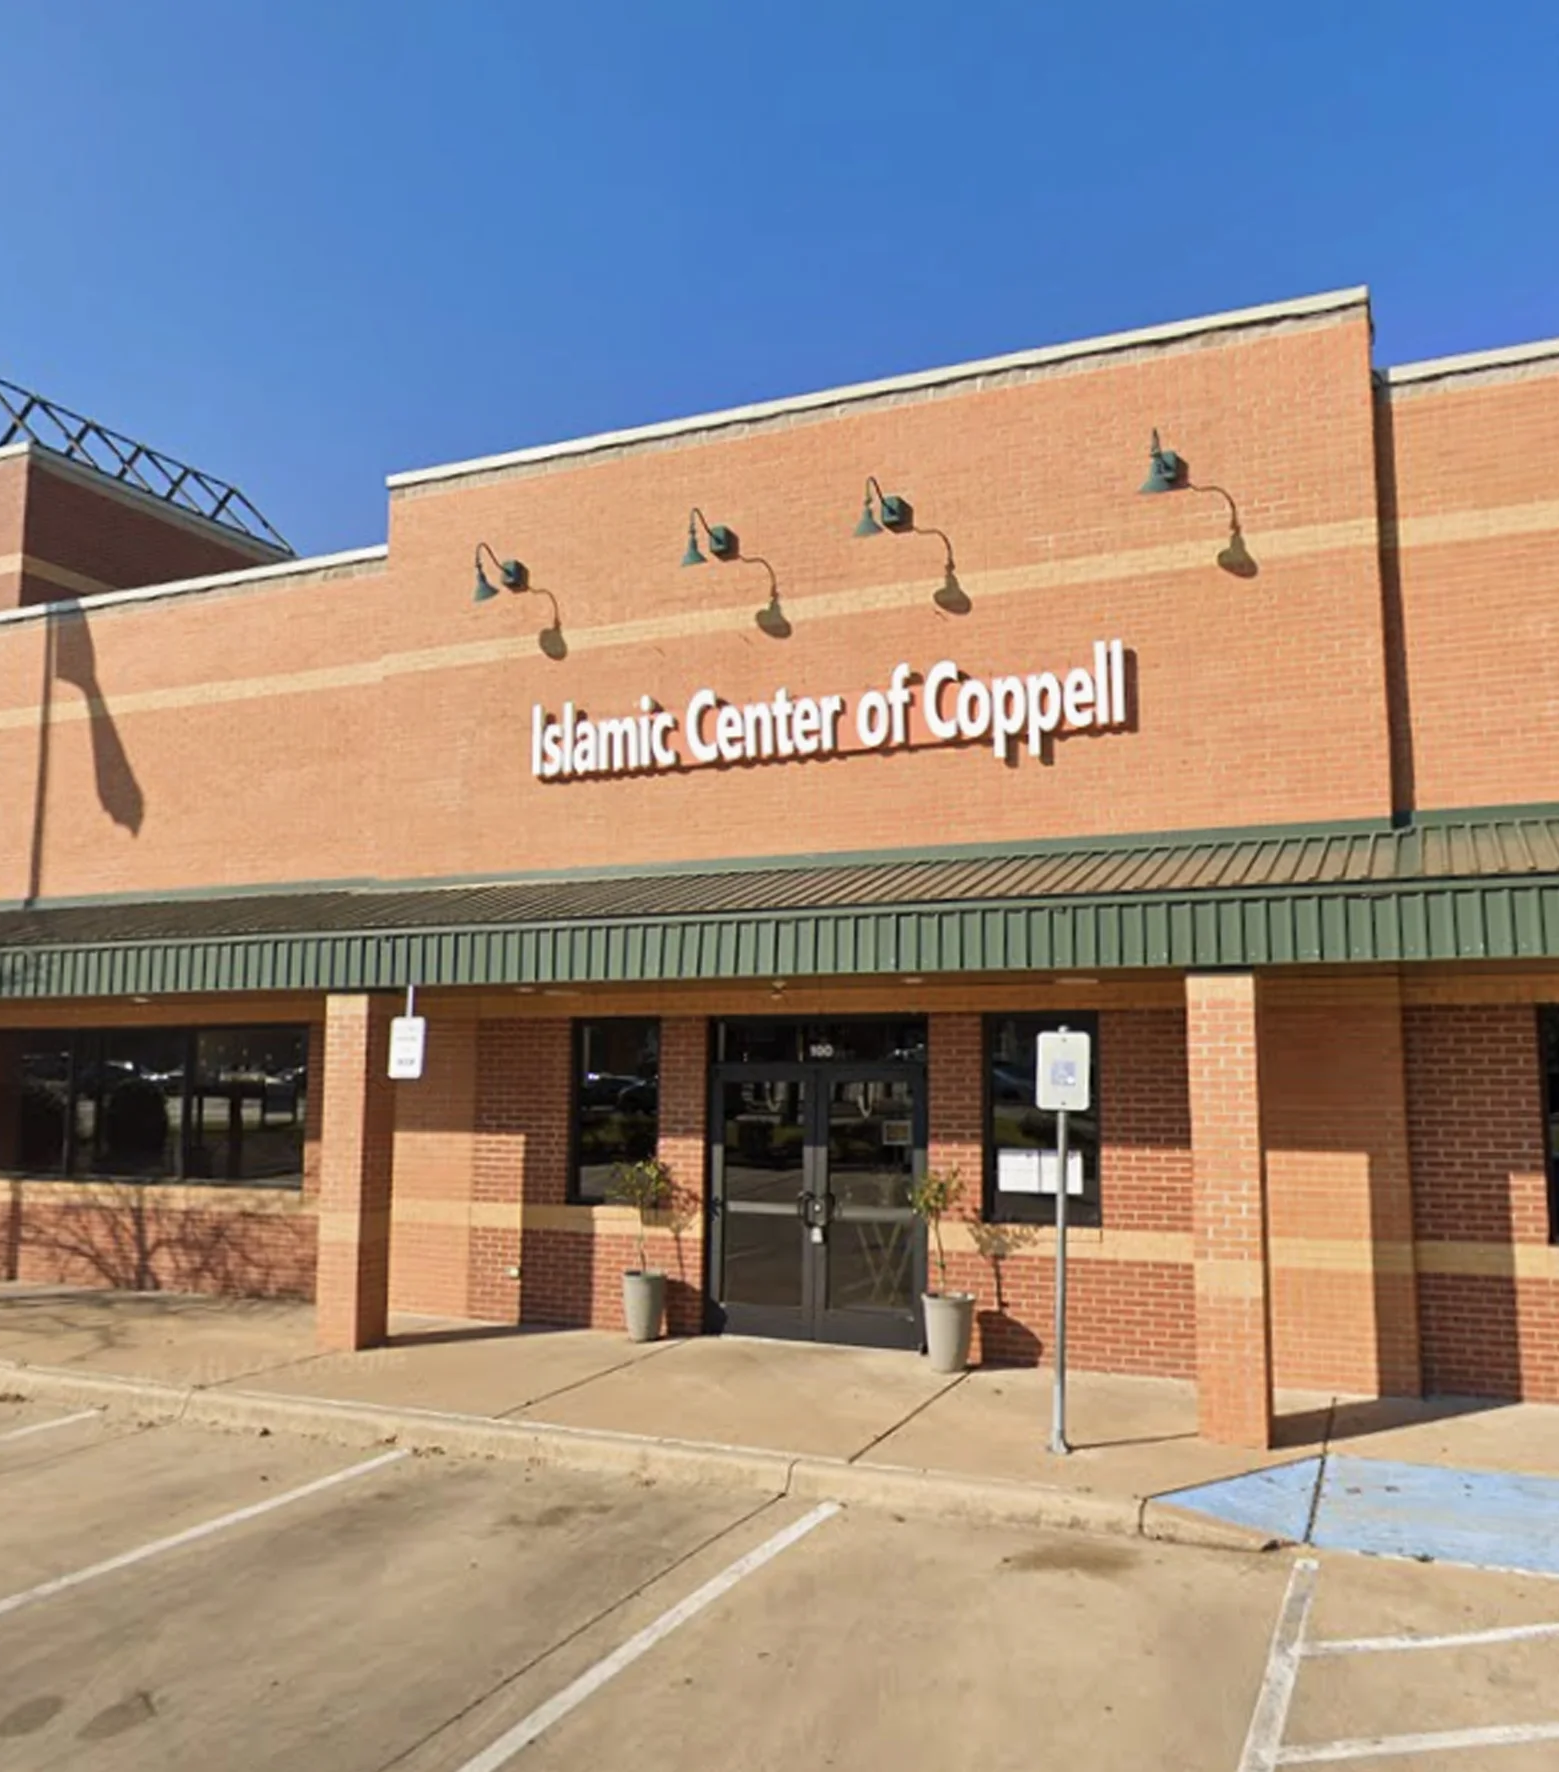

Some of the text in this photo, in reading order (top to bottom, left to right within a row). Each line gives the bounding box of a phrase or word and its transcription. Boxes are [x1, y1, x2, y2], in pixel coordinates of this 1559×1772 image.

[531, 638, 1127, 778] Islamic Center of Coppell
